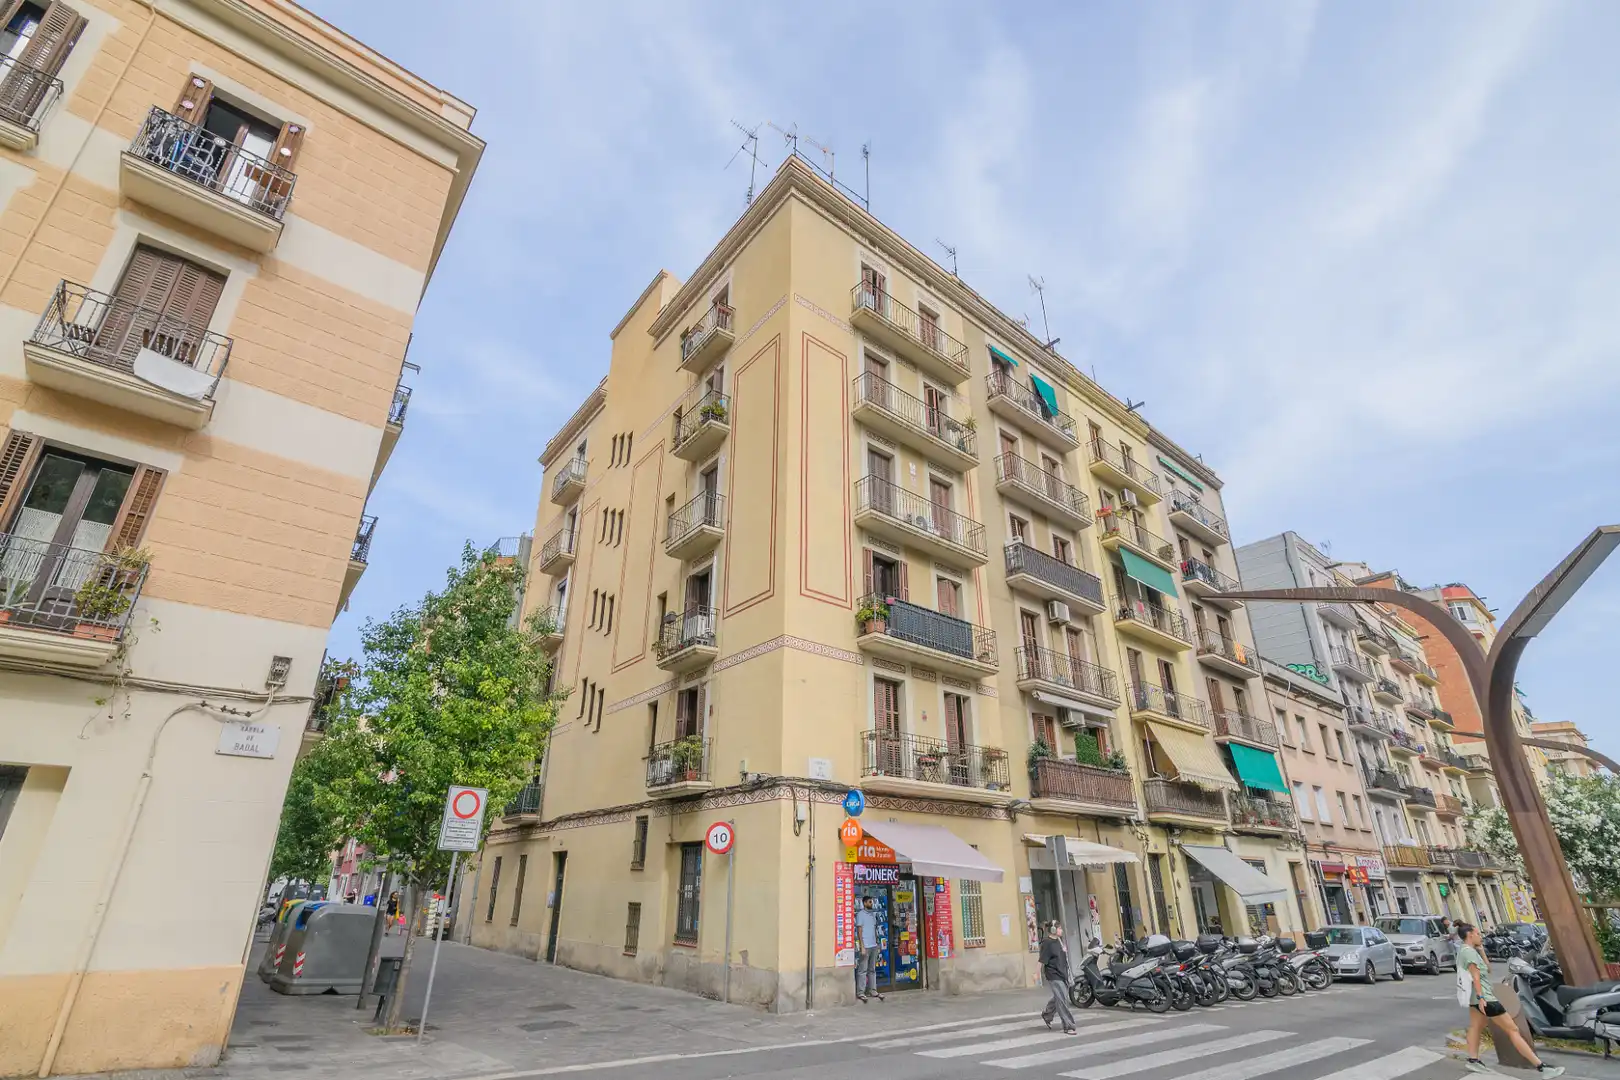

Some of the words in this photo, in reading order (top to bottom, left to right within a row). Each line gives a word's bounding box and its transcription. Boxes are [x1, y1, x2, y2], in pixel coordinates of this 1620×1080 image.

[234, 743, 259, 753] BADAL
[843, 822, 857, 837] ria
[713, 832, 728, 844] 10
[858, 840, 876, 858] ria
